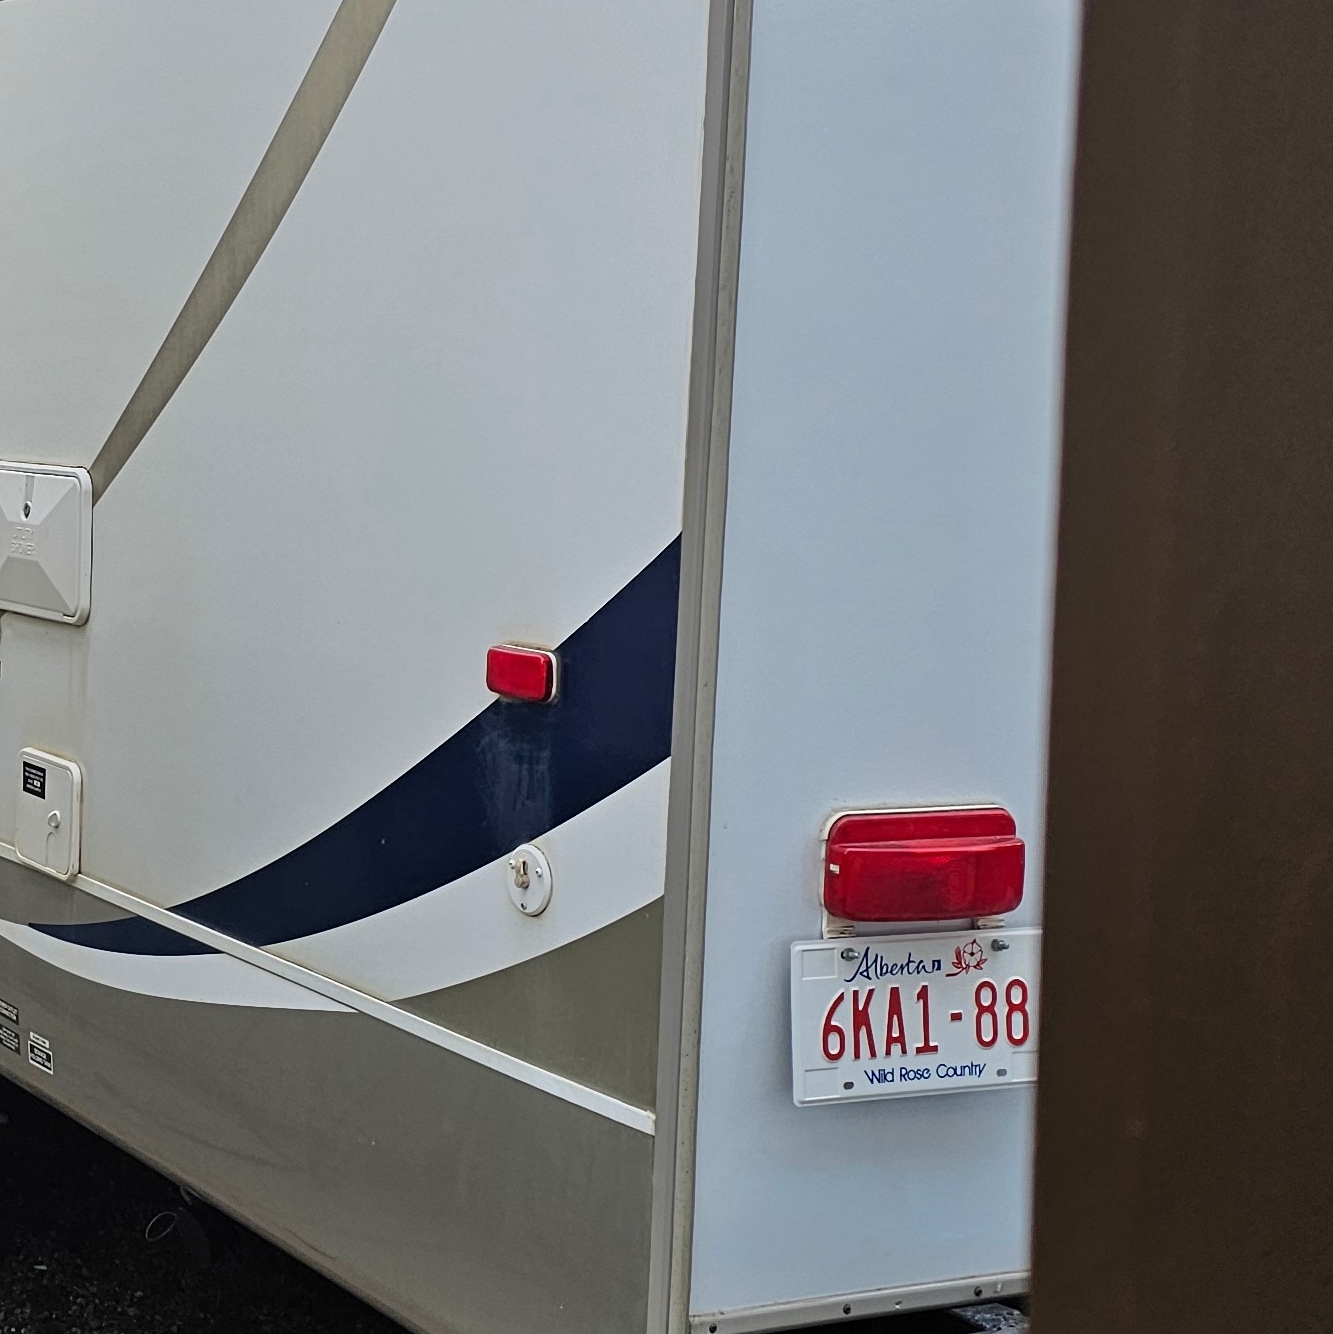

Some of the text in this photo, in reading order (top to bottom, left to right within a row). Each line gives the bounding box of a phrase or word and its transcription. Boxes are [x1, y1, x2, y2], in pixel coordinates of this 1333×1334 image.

[843, 945, 936, 983] Alberta
[821, 978, 1030, 1062] 6KA1-88
[863, 1060, 987, 1085] Wild Rose Country
